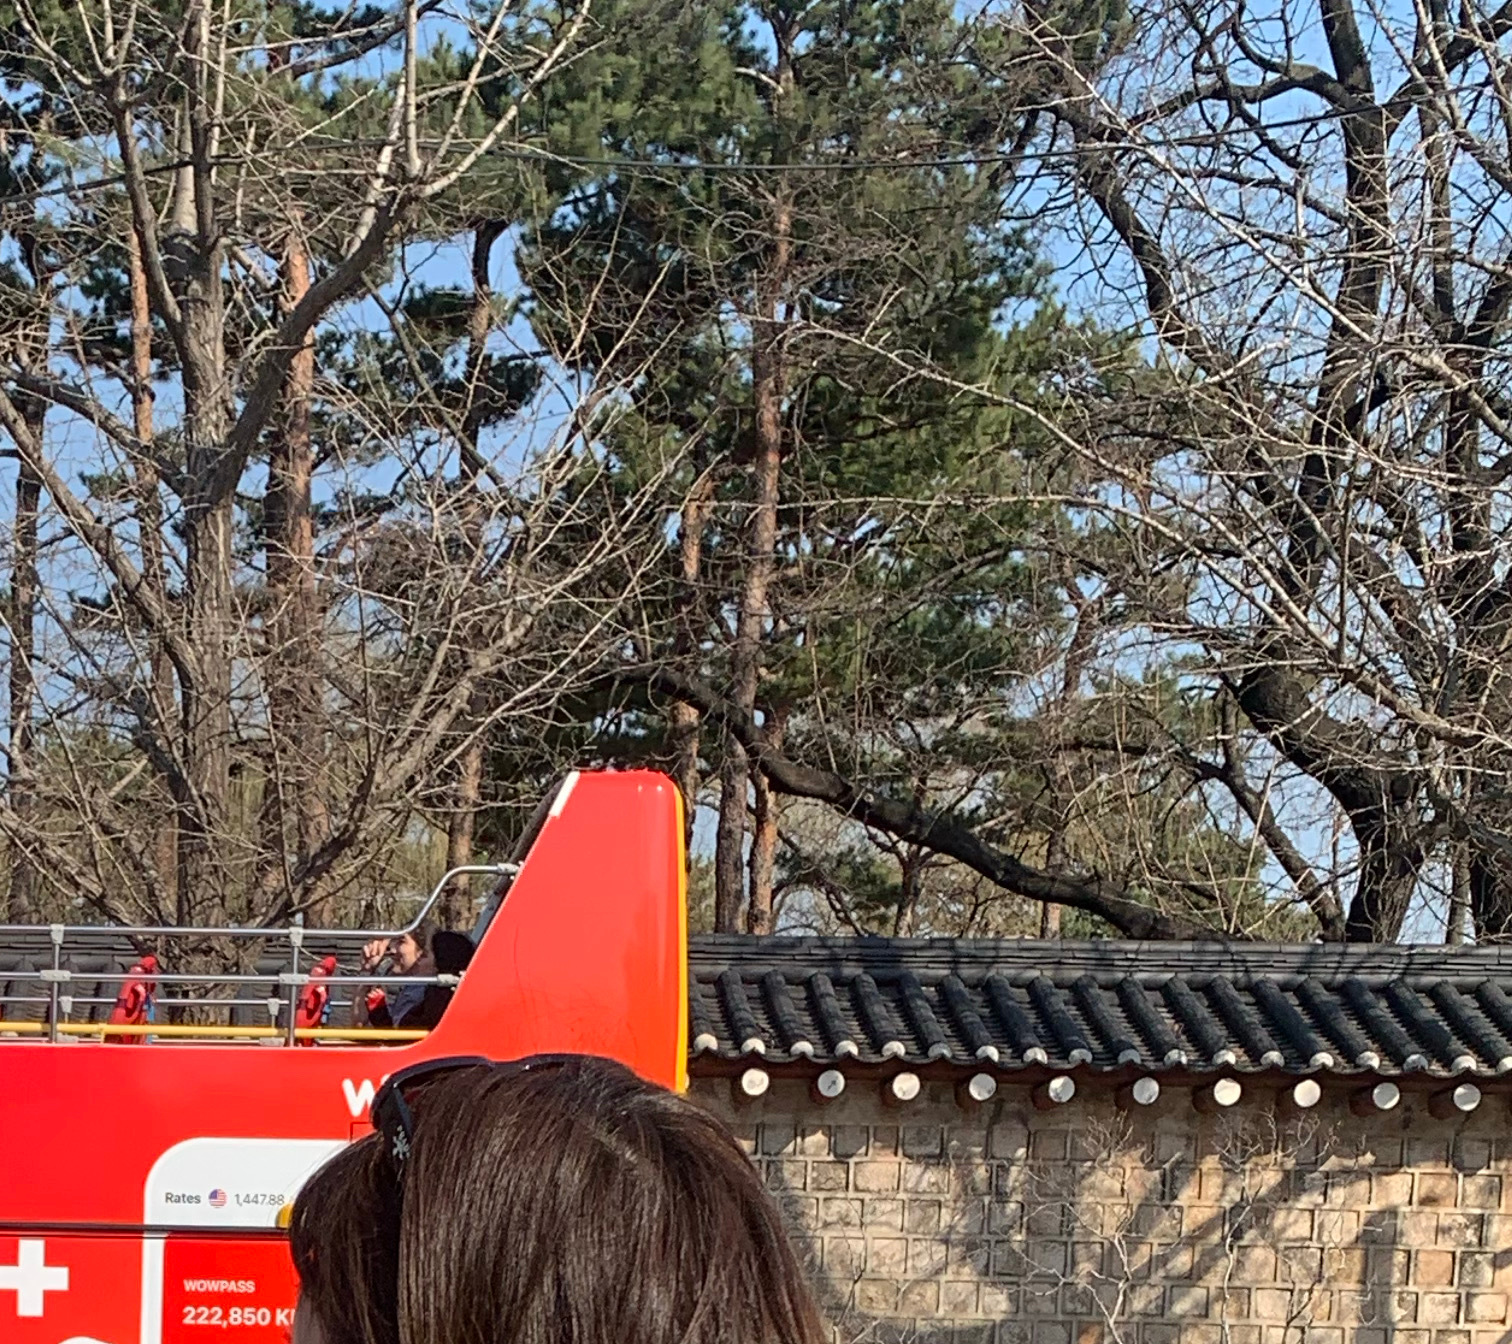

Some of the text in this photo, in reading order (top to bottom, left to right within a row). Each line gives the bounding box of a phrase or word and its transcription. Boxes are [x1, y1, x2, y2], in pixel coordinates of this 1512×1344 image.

[165, 1191, 202, 1205] Rates
[183, 1279, 256, 1294] WOWPASS
[182, 1306, 296, 1328] 222,850 K
